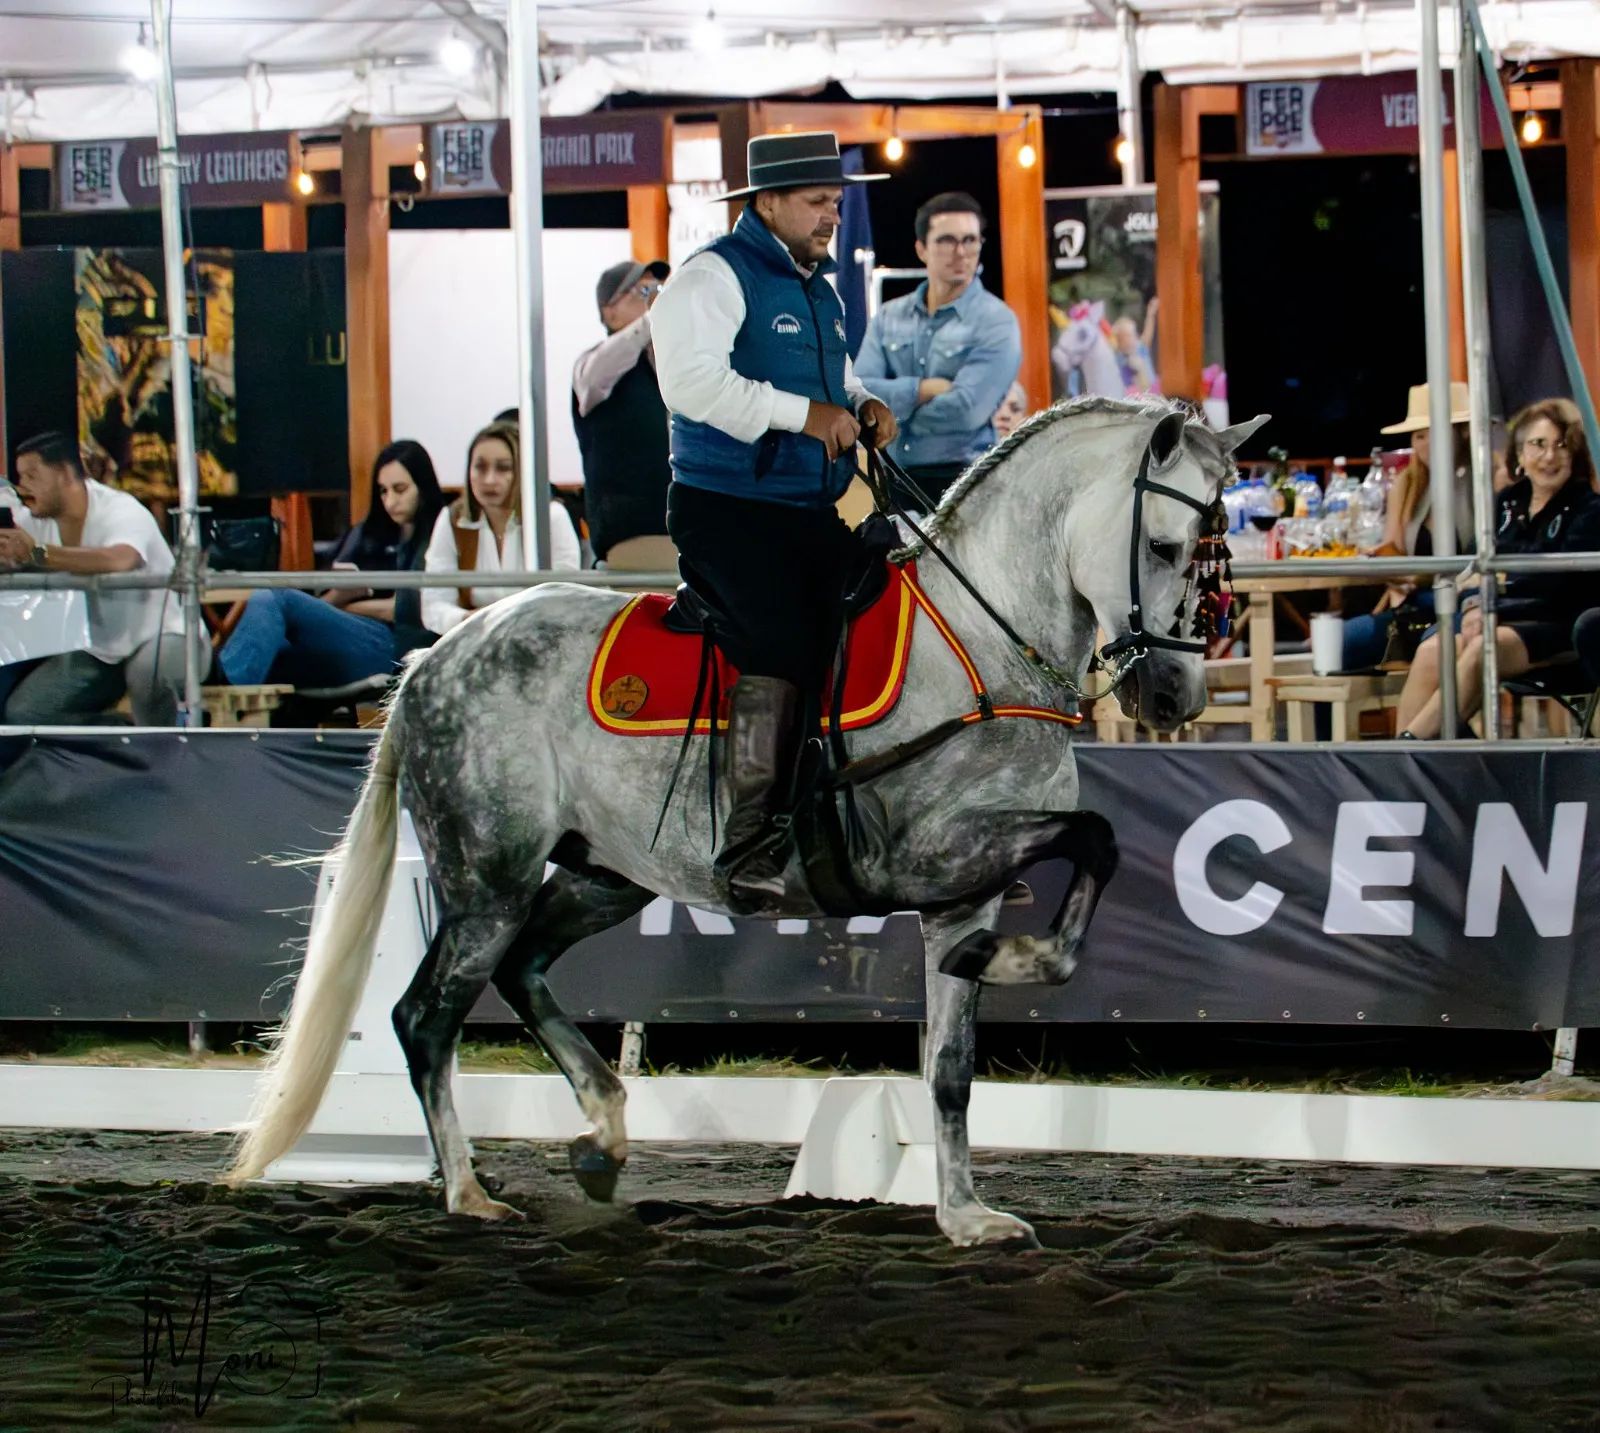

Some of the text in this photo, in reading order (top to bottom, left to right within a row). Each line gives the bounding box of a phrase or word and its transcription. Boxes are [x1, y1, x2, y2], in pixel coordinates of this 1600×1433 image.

[541, 131, 635, 166] RAND PRIX
[138, 149, 287, 187] LURY LEATHERS
[1173, 798, 1588, 938] CEN
